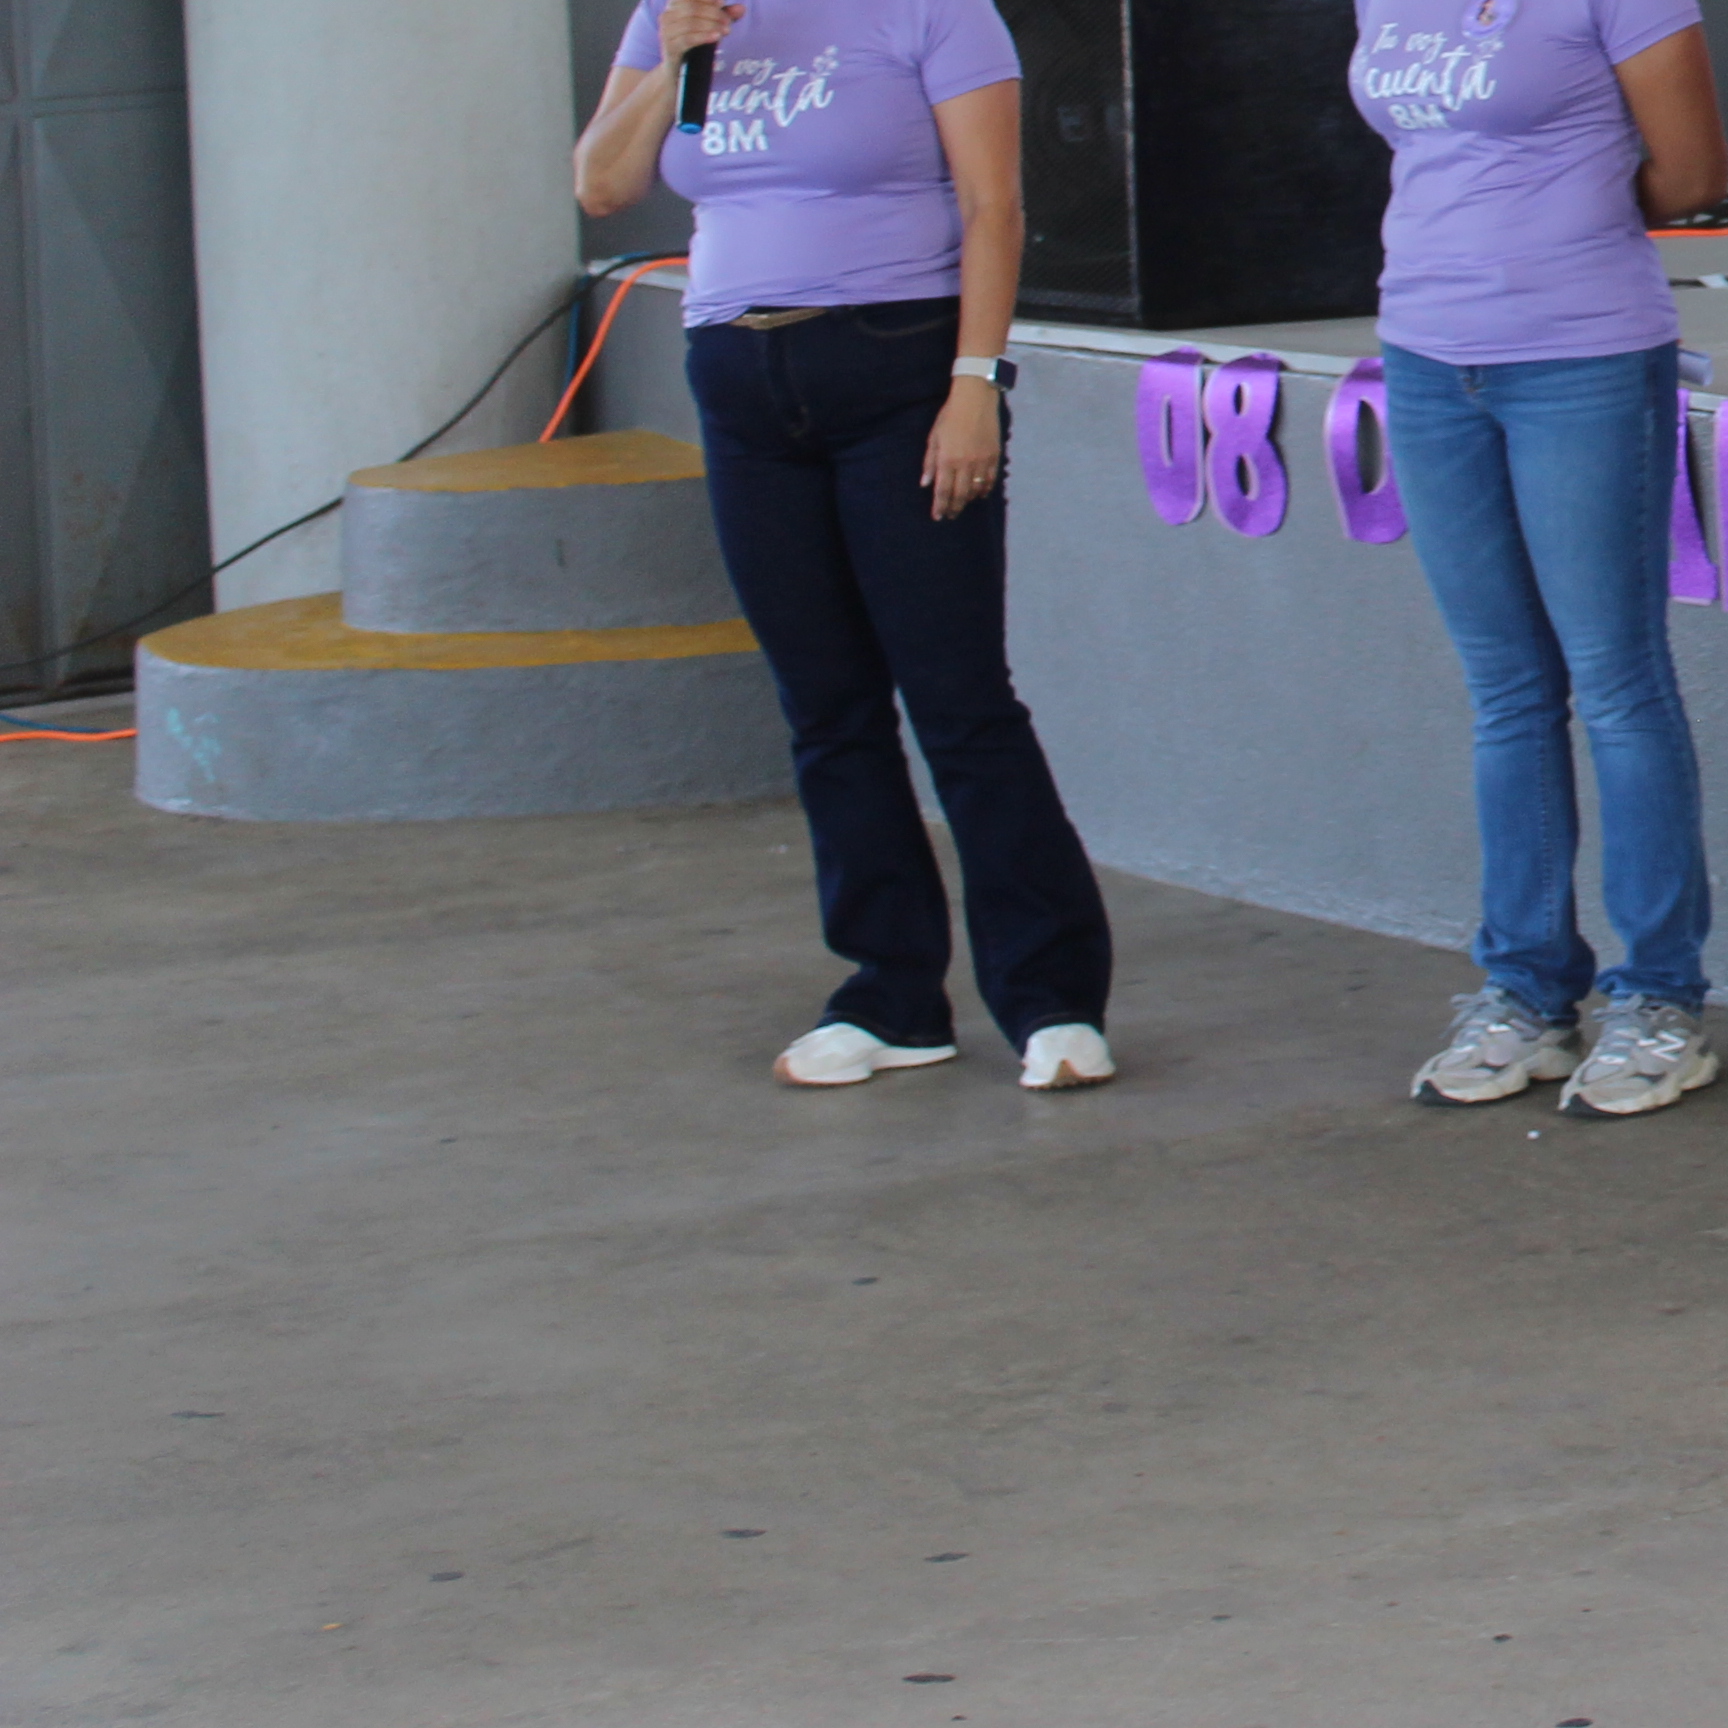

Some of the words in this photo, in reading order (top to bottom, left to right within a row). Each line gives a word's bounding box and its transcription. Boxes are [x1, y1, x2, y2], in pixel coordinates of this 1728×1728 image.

[706, 66, 836, 128] uenta
[701, 119, 770, 156] 8M
[1136, 345, 1290, 538] 08
